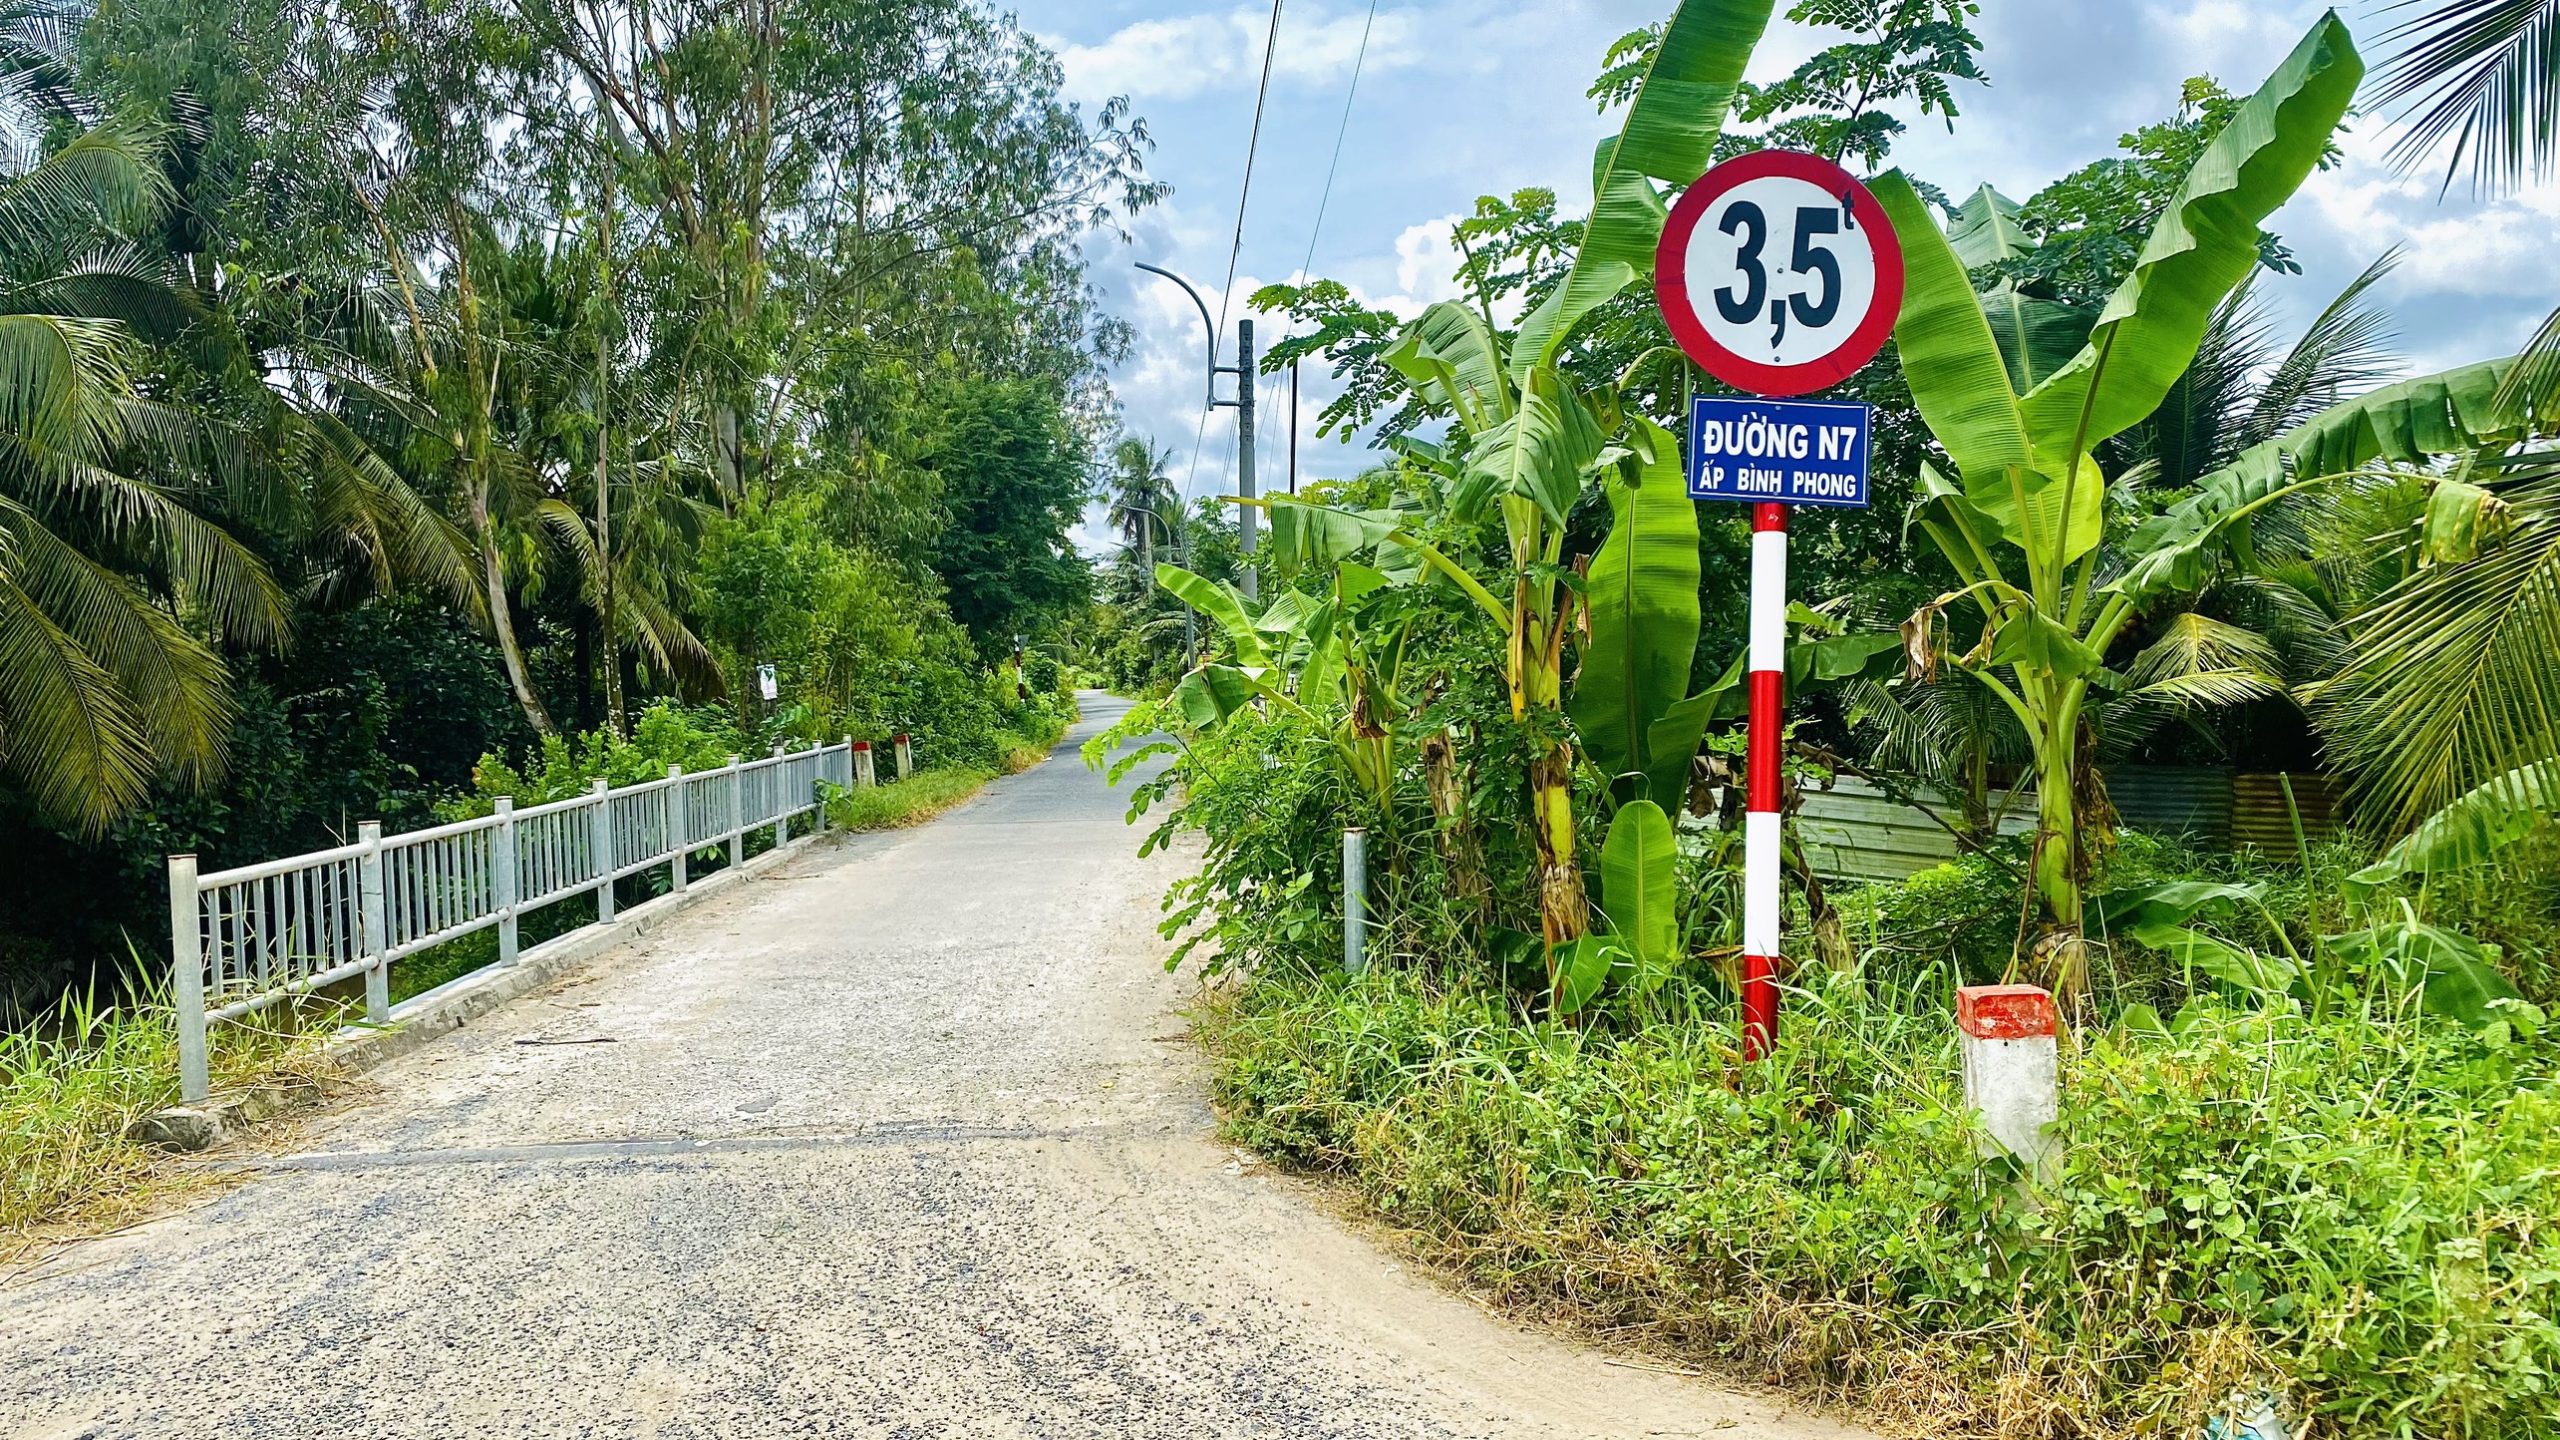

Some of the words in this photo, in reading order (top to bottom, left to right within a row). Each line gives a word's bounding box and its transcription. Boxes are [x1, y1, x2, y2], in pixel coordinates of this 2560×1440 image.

[1703, 412, 1808, 459] ĐƯỜNG
[1818, 426, 1857, 461] N7
[1699, 459, 1725, 490] ẤP
[1737, 463, 1782, 493] BÌNH
[1793, 471, 1856, 497] PHONG
